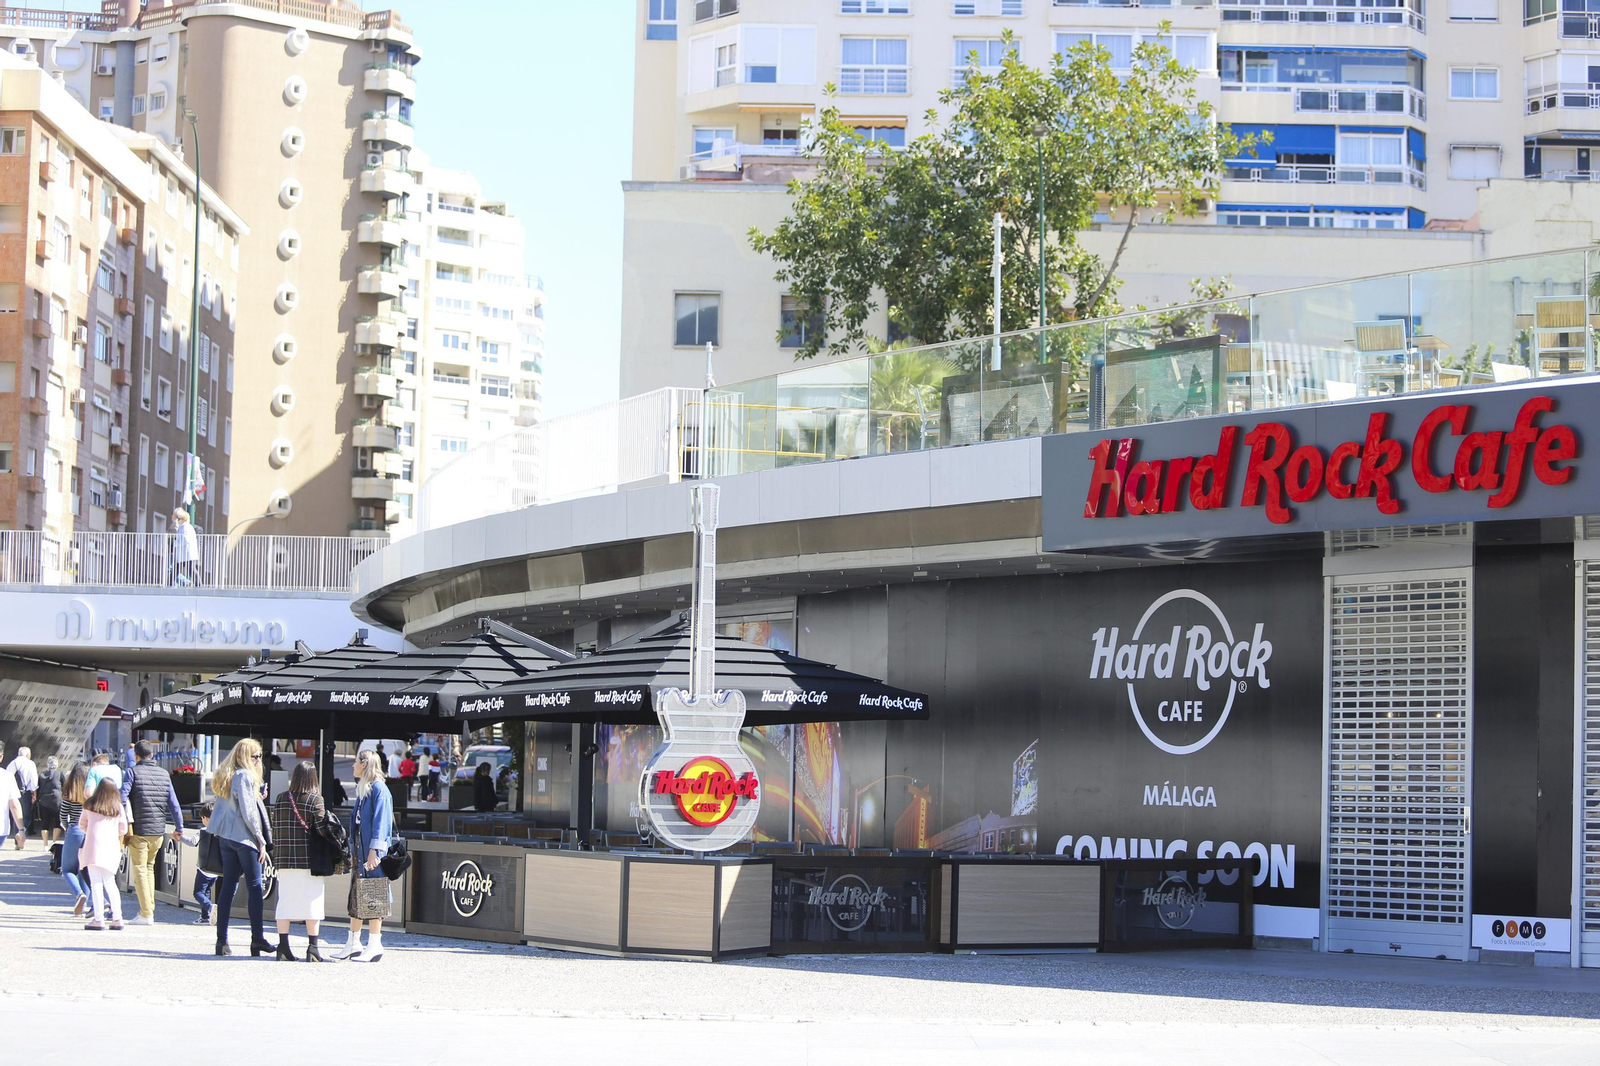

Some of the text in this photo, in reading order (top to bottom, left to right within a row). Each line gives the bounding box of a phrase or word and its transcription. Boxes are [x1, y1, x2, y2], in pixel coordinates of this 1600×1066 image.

[1083, 395, 1577, 524] Hard Rock Cafe
[105, 610, 285, 645] muelleuno
[1089, 622, 1273, 691] Hard Rock
[330, 692, 370, 705] Hard Rock Cafe
[460, 697, 504, 713] Hard Rock Cafe
[525, 692, 570, 707] Hard Rock Cafe
[594, 691, 611, 703] Hard
[611, 690, 627, 704] Rock
[627, 690, 642, 704] Cafe
[761, 690, 828, 705] Hard Rock Cafe
[859, 694, 923, 711] Hard Rock Cafe
[1157, 701, 1203, 722] CAFE
[654, 770, 759, 800] Hard Rock
[1143, 781, 1217, 807] MÁLAGA
[693, 802, 721, 813] CAFE
[1197, 840, 1296, 889] SOON
[441, 870, 493, 896] Hard Rock
[460, 897, 474, 906] CAFE
[808, 886, 886, 909] Hard Rock
[1142, 886, 1207, 908] Hard Rock
[839, 912, 859, 920] CAFE
